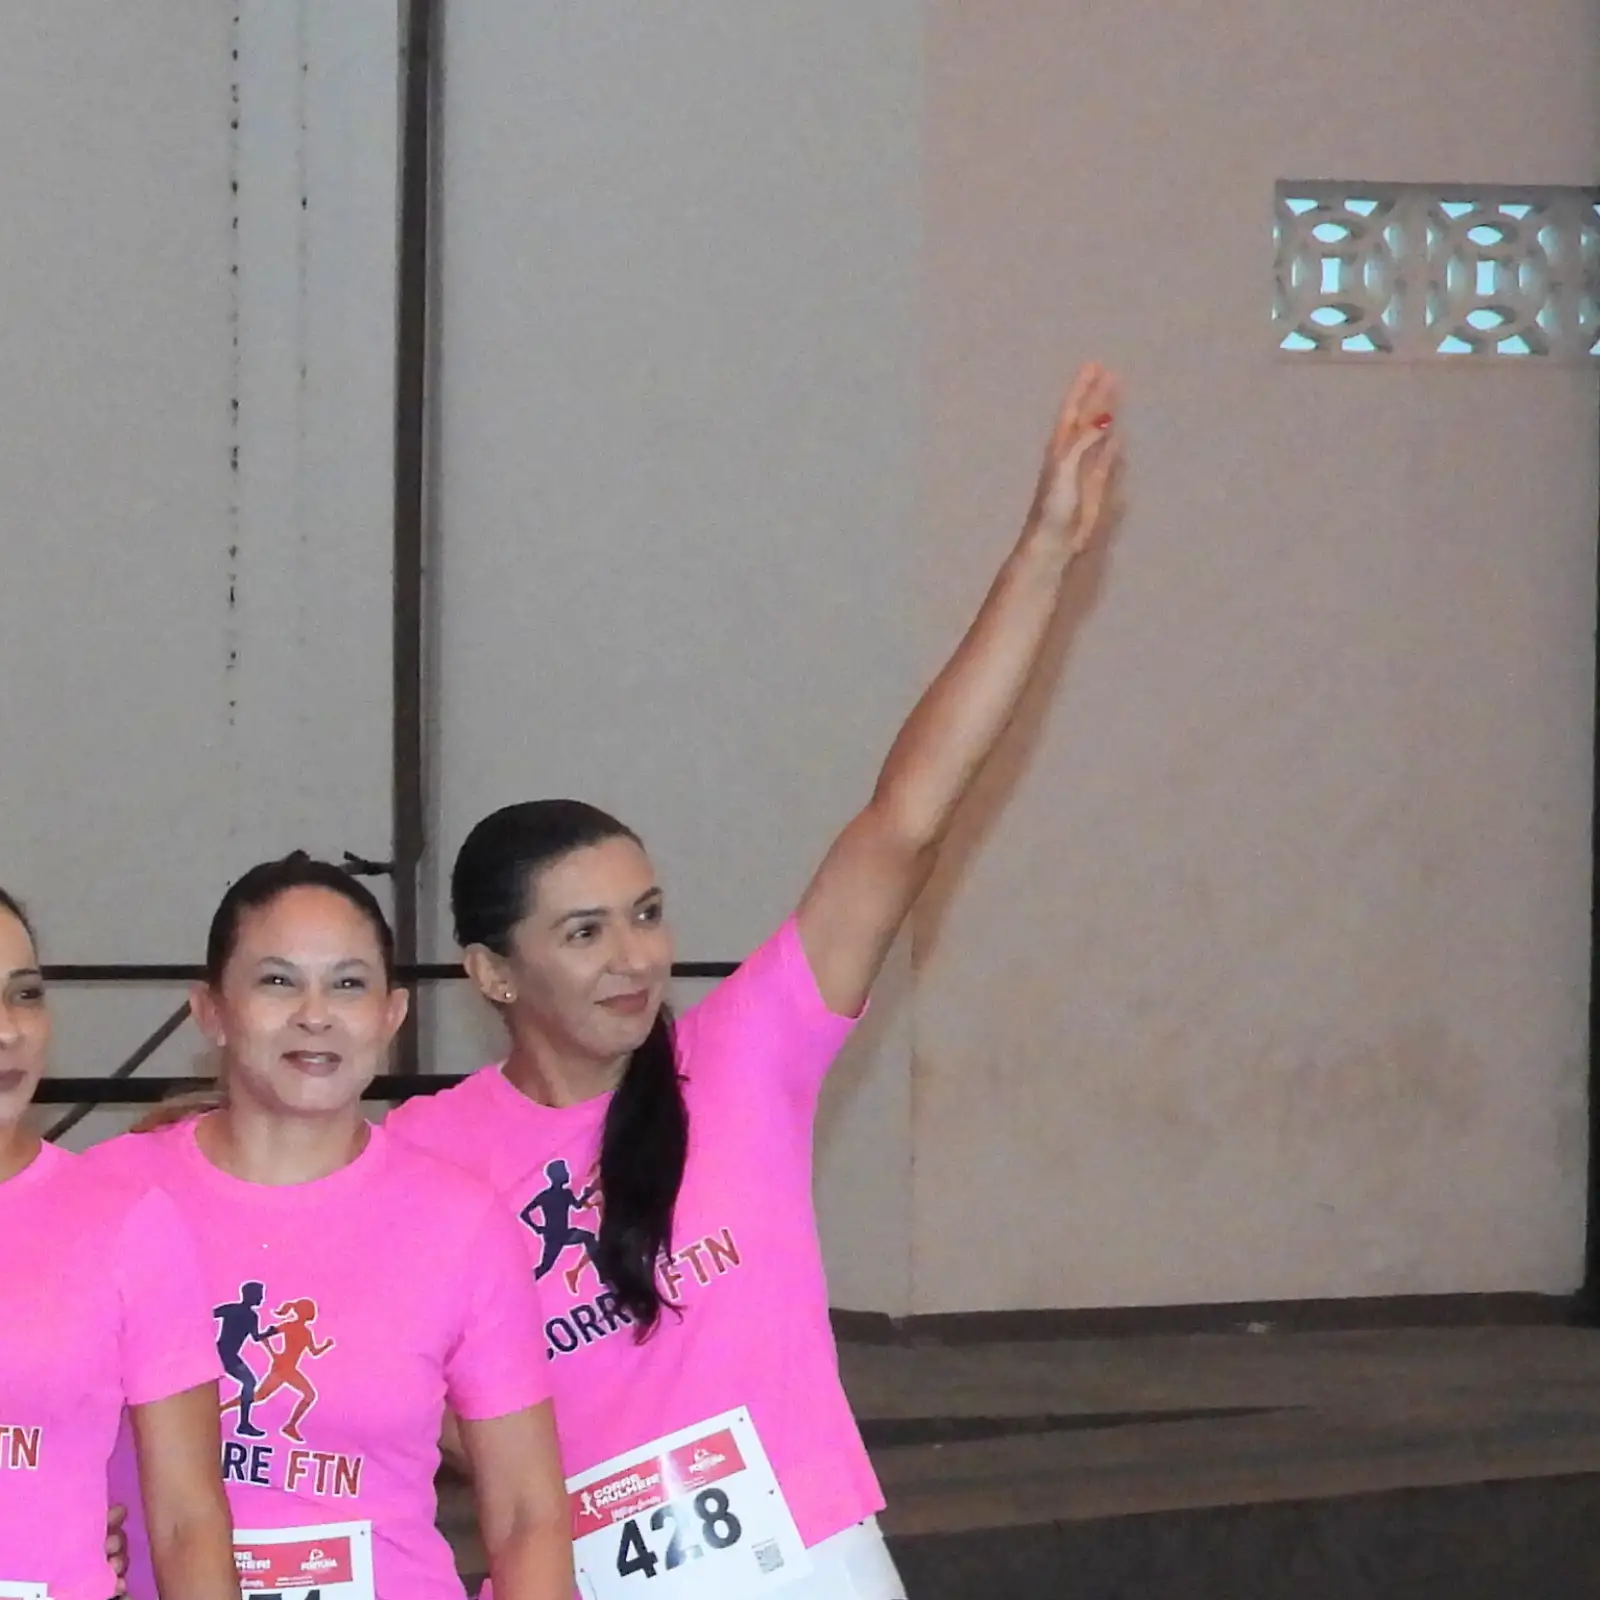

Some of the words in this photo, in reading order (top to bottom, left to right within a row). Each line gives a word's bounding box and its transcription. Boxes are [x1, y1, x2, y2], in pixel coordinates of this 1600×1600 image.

[545, 1290, 633, 1361] ORR
[286, 1449, 363, 1496] FTN
[616, 1486, 743, 1579] 428
